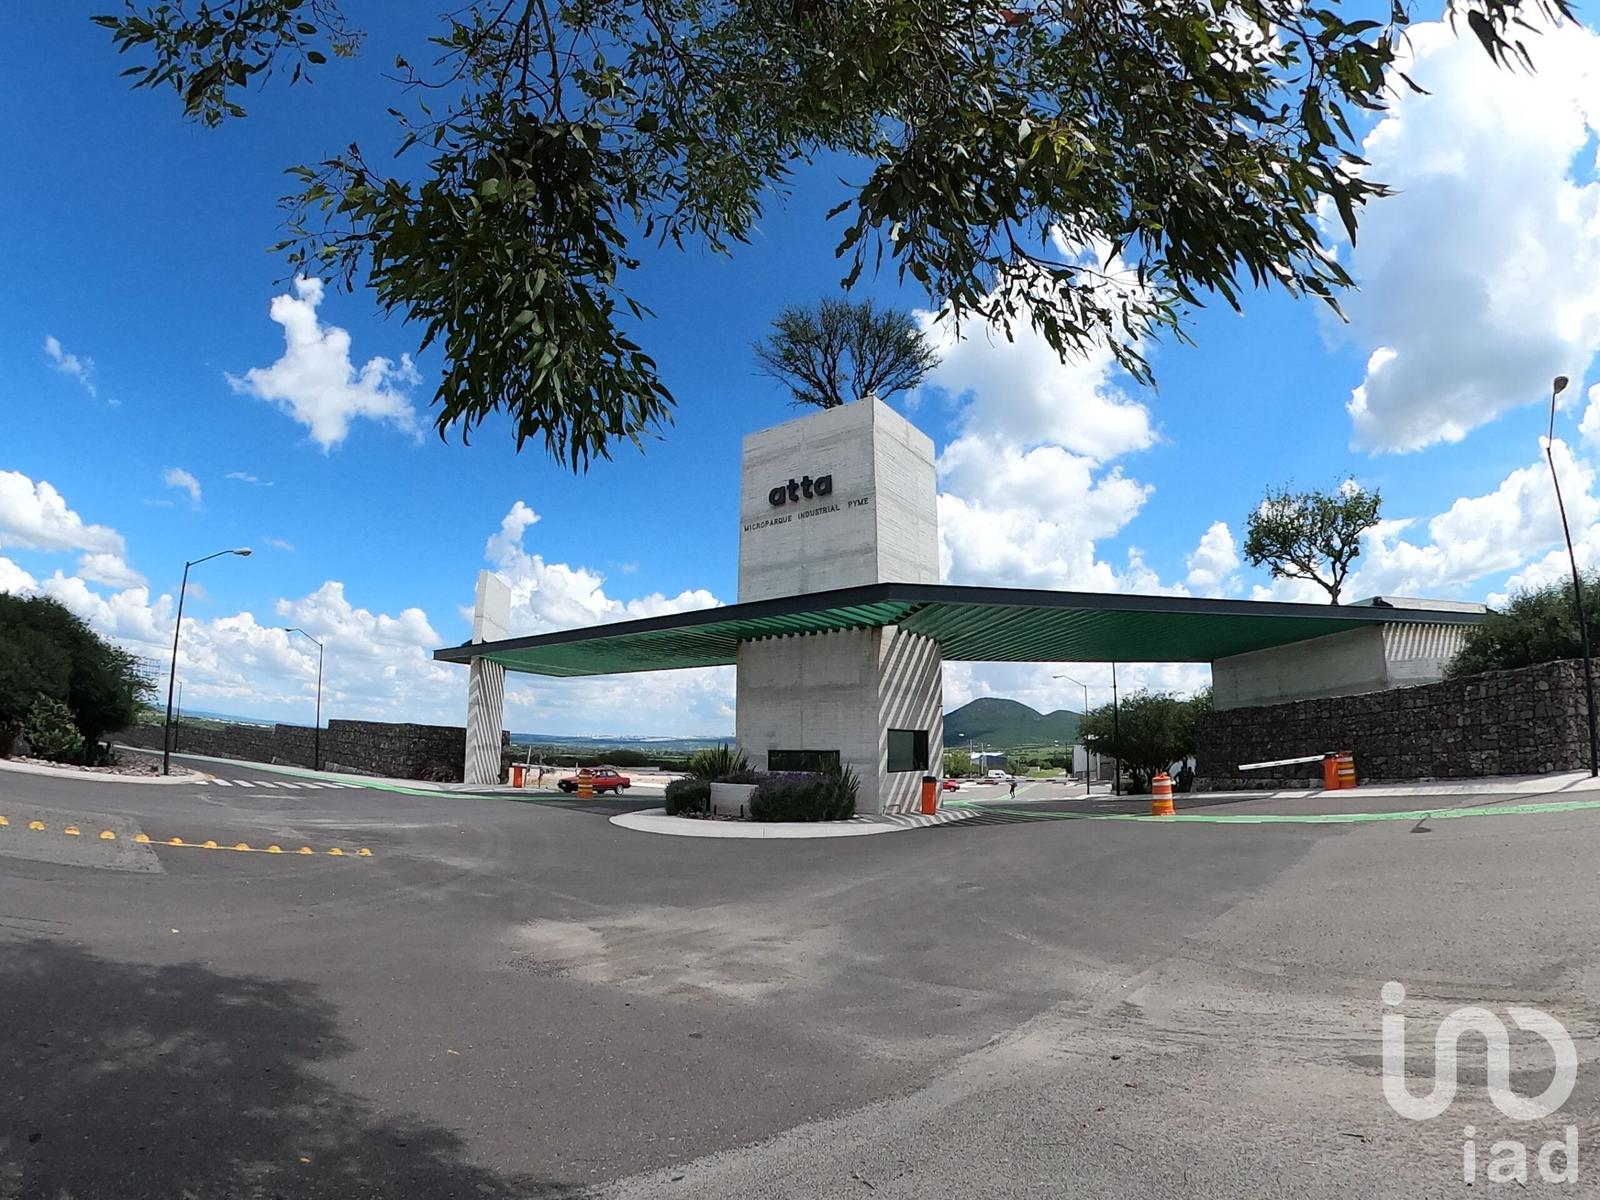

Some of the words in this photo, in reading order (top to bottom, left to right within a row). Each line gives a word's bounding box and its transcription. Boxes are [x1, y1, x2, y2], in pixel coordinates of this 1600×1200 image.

[769, 474, 833, 506] atta
[744, 514, 792, 532] MICROPARQUE
[797, 504, 840, 520] INDUSTRIAL
[848, 497, 869, 508] PYME
